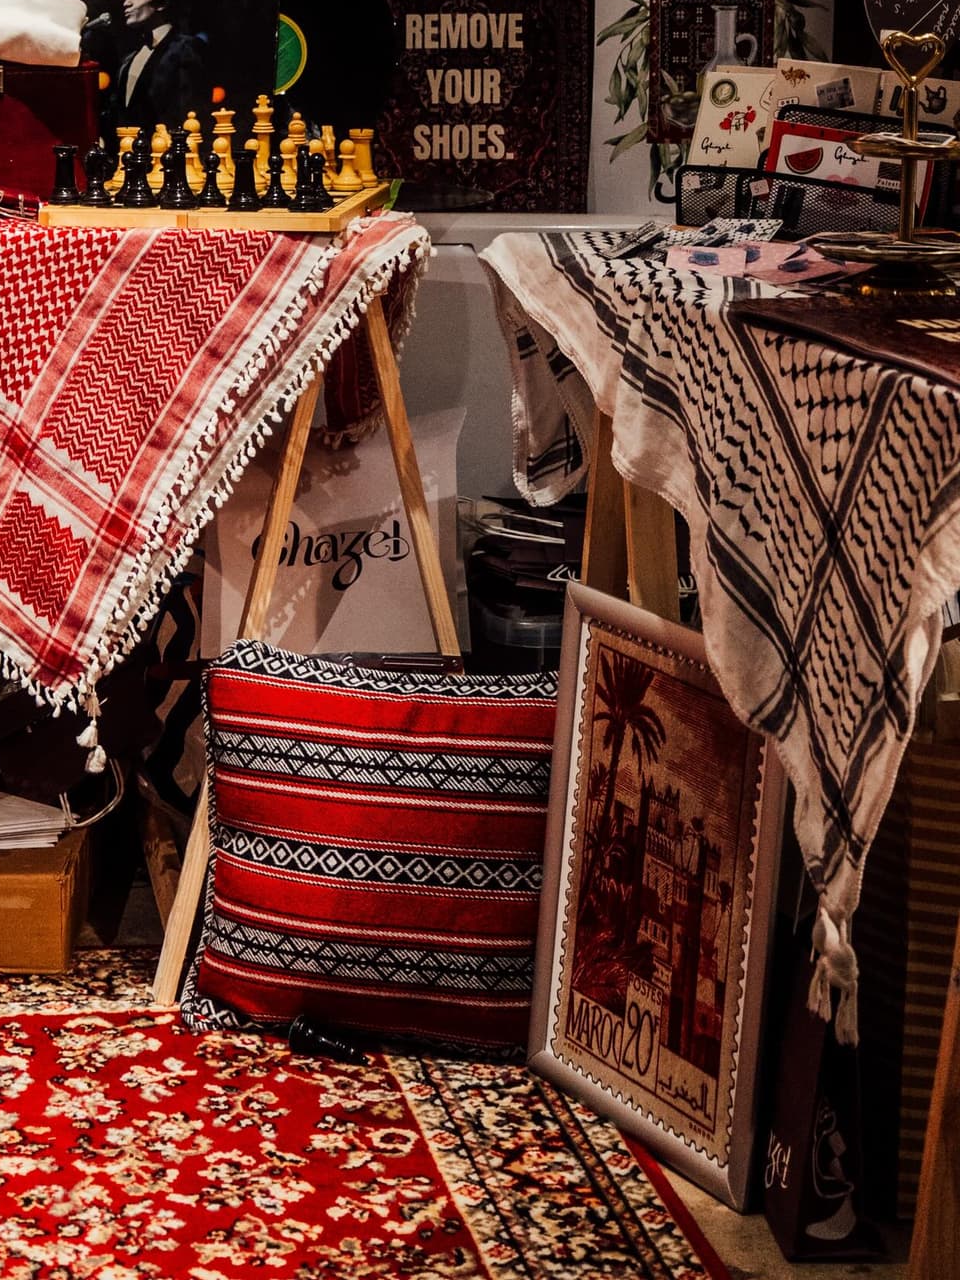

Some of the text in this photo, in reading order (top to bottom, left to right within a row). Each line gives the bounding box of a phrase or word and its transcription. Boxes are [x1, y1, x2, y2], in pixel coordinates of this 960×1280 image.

[405, 13, 524, 50] REMOVE
[426, 68, 501, 104] YOUR
[413, 124, 514, 161] SHOES.
[627, 972, 663, 1006] POSTES
[565, 991, 624, 1066] MAROC
